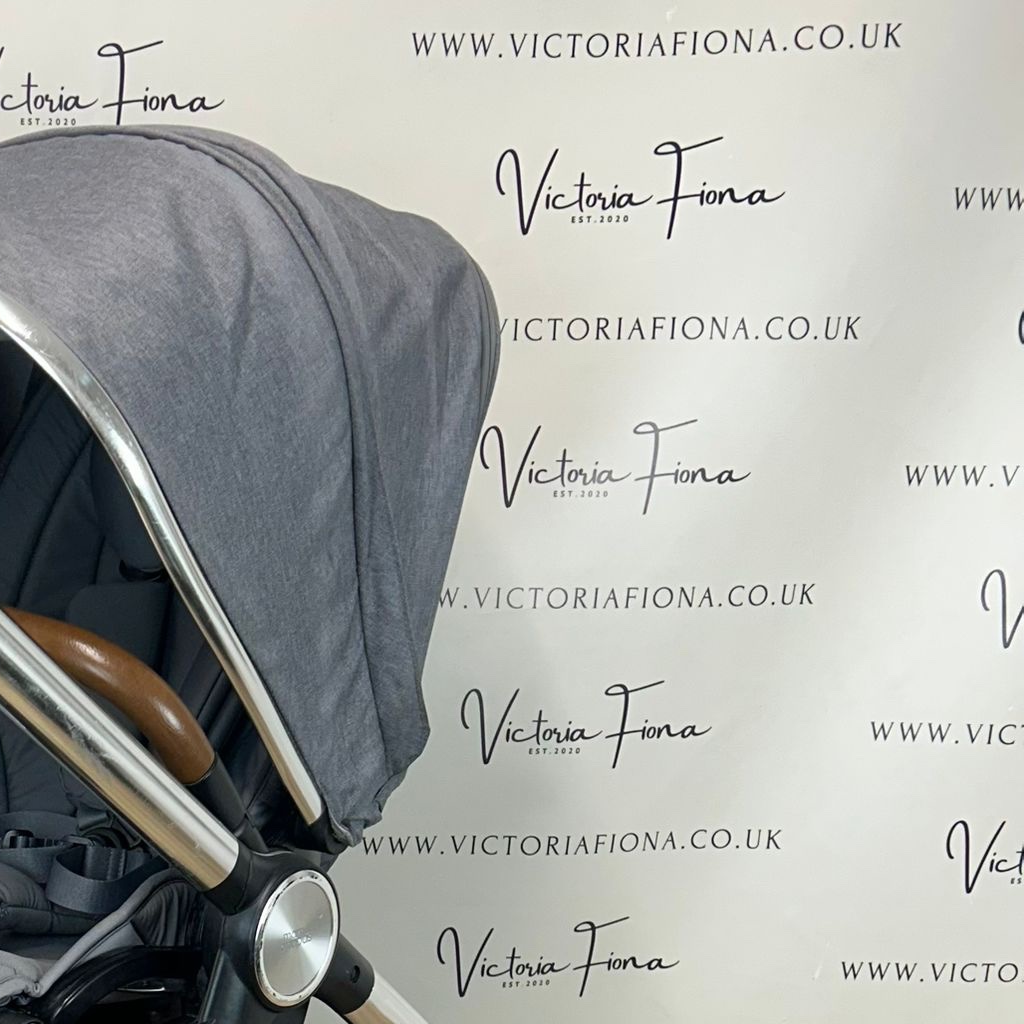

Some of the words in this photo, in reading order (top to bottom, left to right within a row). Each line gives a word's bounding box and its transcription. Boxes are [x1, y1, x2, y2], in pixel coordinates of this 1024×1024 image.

[412, 22, 903, 58] WWW.VICTORIAFIONA.CO.UK
[97, 40, 226, 126] Fiona
[20, 118, 76, 126] EST.2020
[496, 148, 653, 237] Victoria
[653, 136, 786, 240] Fiona
[571, 215, 629, 223] EST.2020
[480, 425, 631, 508] Victoria
[632, 419, 751, 515] Fiona
[553, 490, 609, 498] EST.2020
[461, 688, 603, 765] Victoria
[604, 681, 712, 769] Fiona
[529, 747, 581, 755] EST.2020
[362, 828, 783, 856] WWW.VICTORIAFIONA.CO.UK
[437, 927, 570, 998] Victoria
[572, 917, 680, 998] Fiona
[842, 961, 1024, 983] WWW.VICTO
